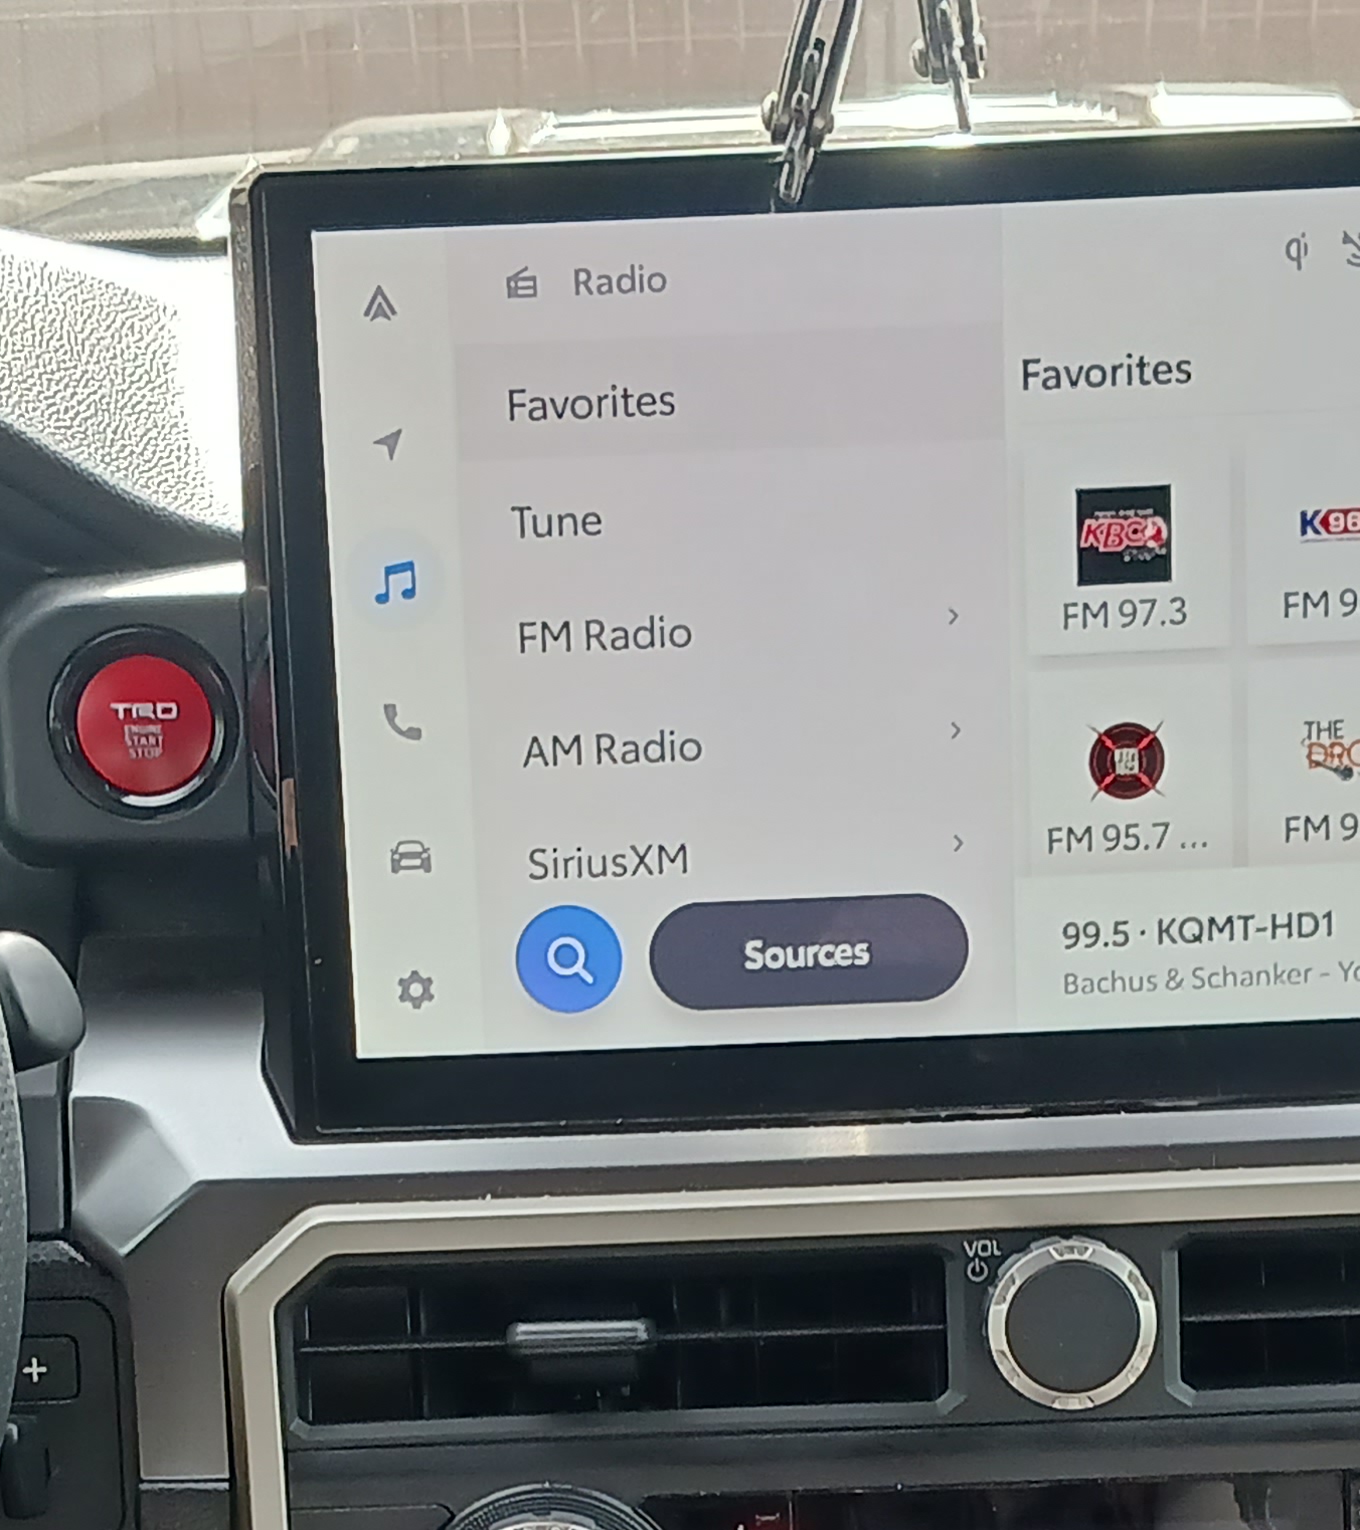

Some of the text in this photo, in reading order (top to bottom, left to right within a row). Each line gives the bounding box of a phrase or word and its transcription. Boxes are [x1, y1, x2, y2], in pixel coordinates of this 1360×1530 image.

[573, 263, 667, 297] Radio
[1022, 352, 1192, 391] Favorites
[508, 384, 676, 422] Favorites
[510, 505, 602, 539] Tune
[1063, 596, 1188, 631] FM 97.3
[1283, 590, 1330, 619] FM
[518, 614, 692, 654] FM Radio
[110, 702, 179, 721] TRD
[126, 735, 164, 748] START
[1301, 718, 1345, 742] THE
[130, 747, 163, 759] STOP
[522, 729, 703, 768] AM Radio
[1047, 825, 1093, 855] FM
[1102, 821, 1171, 852] 95.7
[1285, 814, 1331, 844] FM
[528, 842, 688, 881] SiriusXM
[1062, 920, 1130, 950] 99.5
[1157, 909, 1333, 946] KQMT-HD1
[744, 939, 870, 970] Sources
[1063, 969, 1158, 995] Bachus
[1164, 967, 1185, 992] &
[1191, 961, 1313, 990] Schanker
[963, 1239, 1002, 1258] VOL
